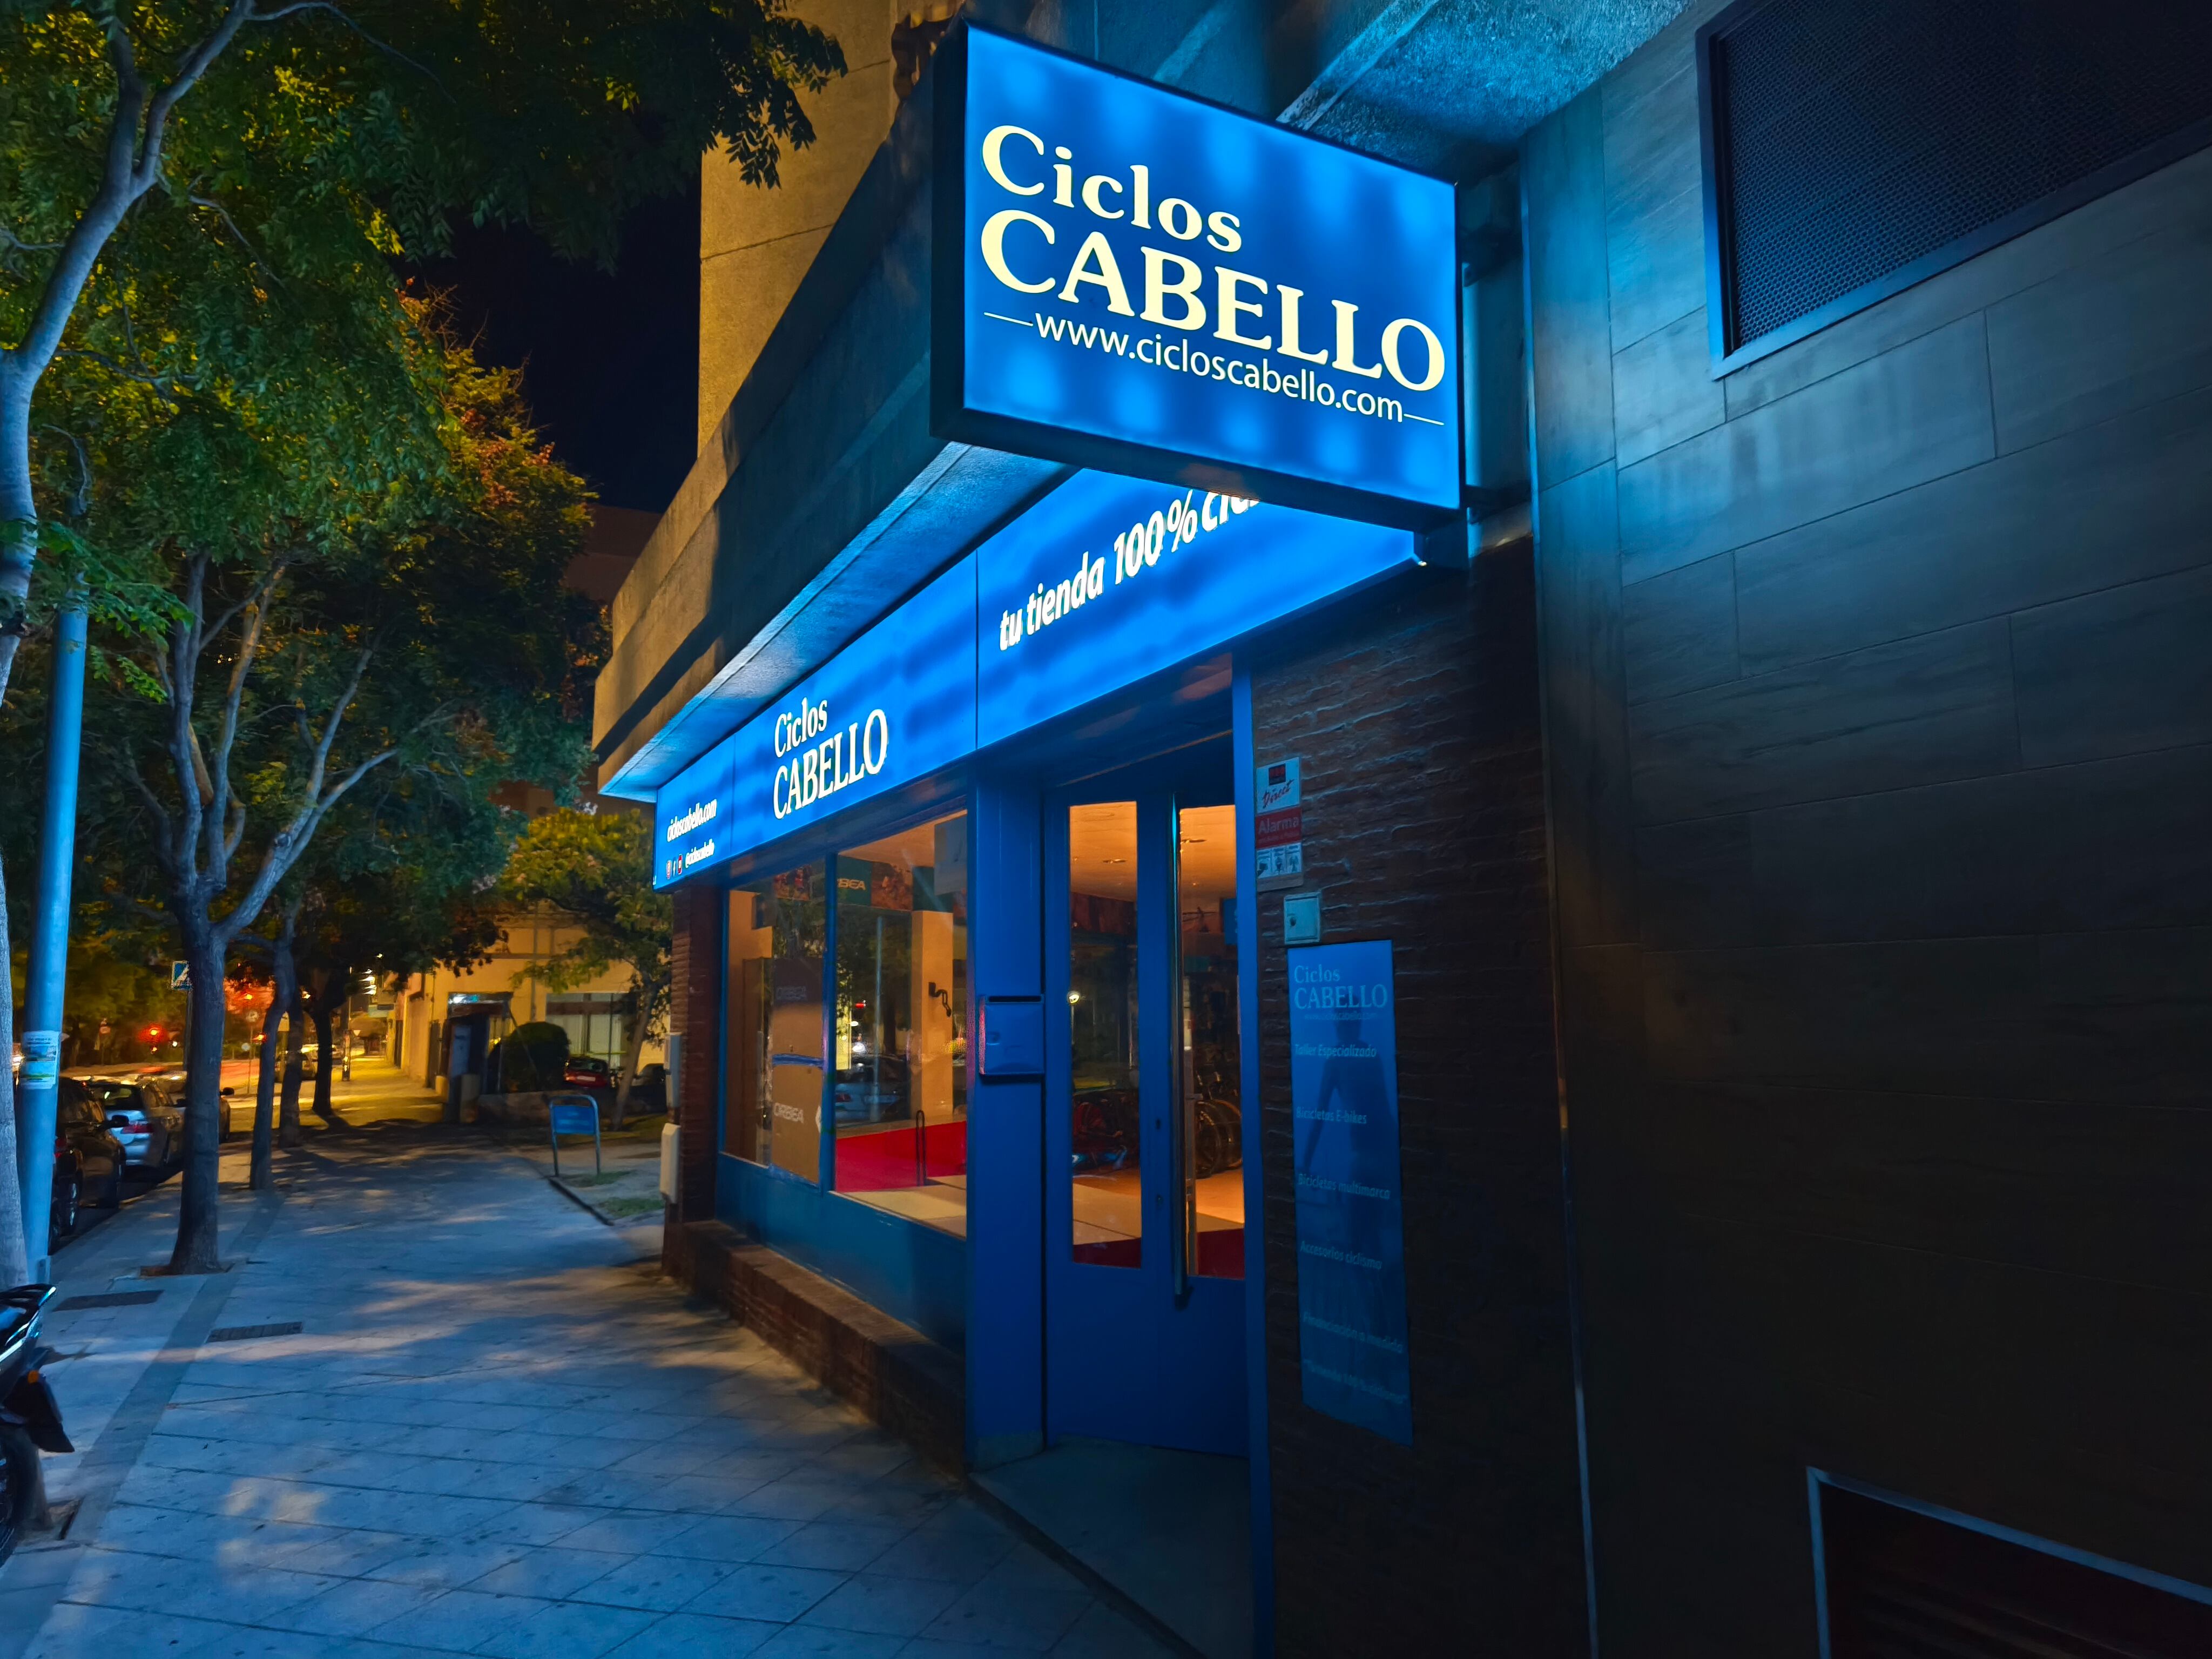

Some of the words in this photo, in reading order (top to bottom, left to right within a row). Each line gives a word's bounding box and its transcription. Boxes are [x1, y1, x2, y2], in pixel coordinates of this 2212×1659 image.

[982, 124, 1242, 253] Ciclos
[980, 208, 1445, 392] CABELLO
[1035, 312, 1403, 423] www.cicloscabello.com
[1000, 610, 1023, 650] tu
[1026, 552, 1105, 632] tienda
[1114, 489, 1198, 584] 100%
[775, 697, 827, 758] Ciclos
[773, 709, 888, 820] CABELLO
[667, 799, 717, 842] cicloscabello.com
[1258, 817, 1299, 834] Alarma
[838, 878, 866, 891] BEA
[1294, 964, 1340, 983] Ciclos
[1294, 984, 1388, 1009] CABELLO
[1294, 1043, 1317, 1055] Taller
[1318, 1043, 1377, 1059] Especializado
[1296, 1106, 1334, 1121] Bicicletas
[1297, 1173, 1336, 1190] Bicicletas
[1338, 1181, 1391, 1200] multimarca
[1300, 1240, 1344, 1261] Accesorios
